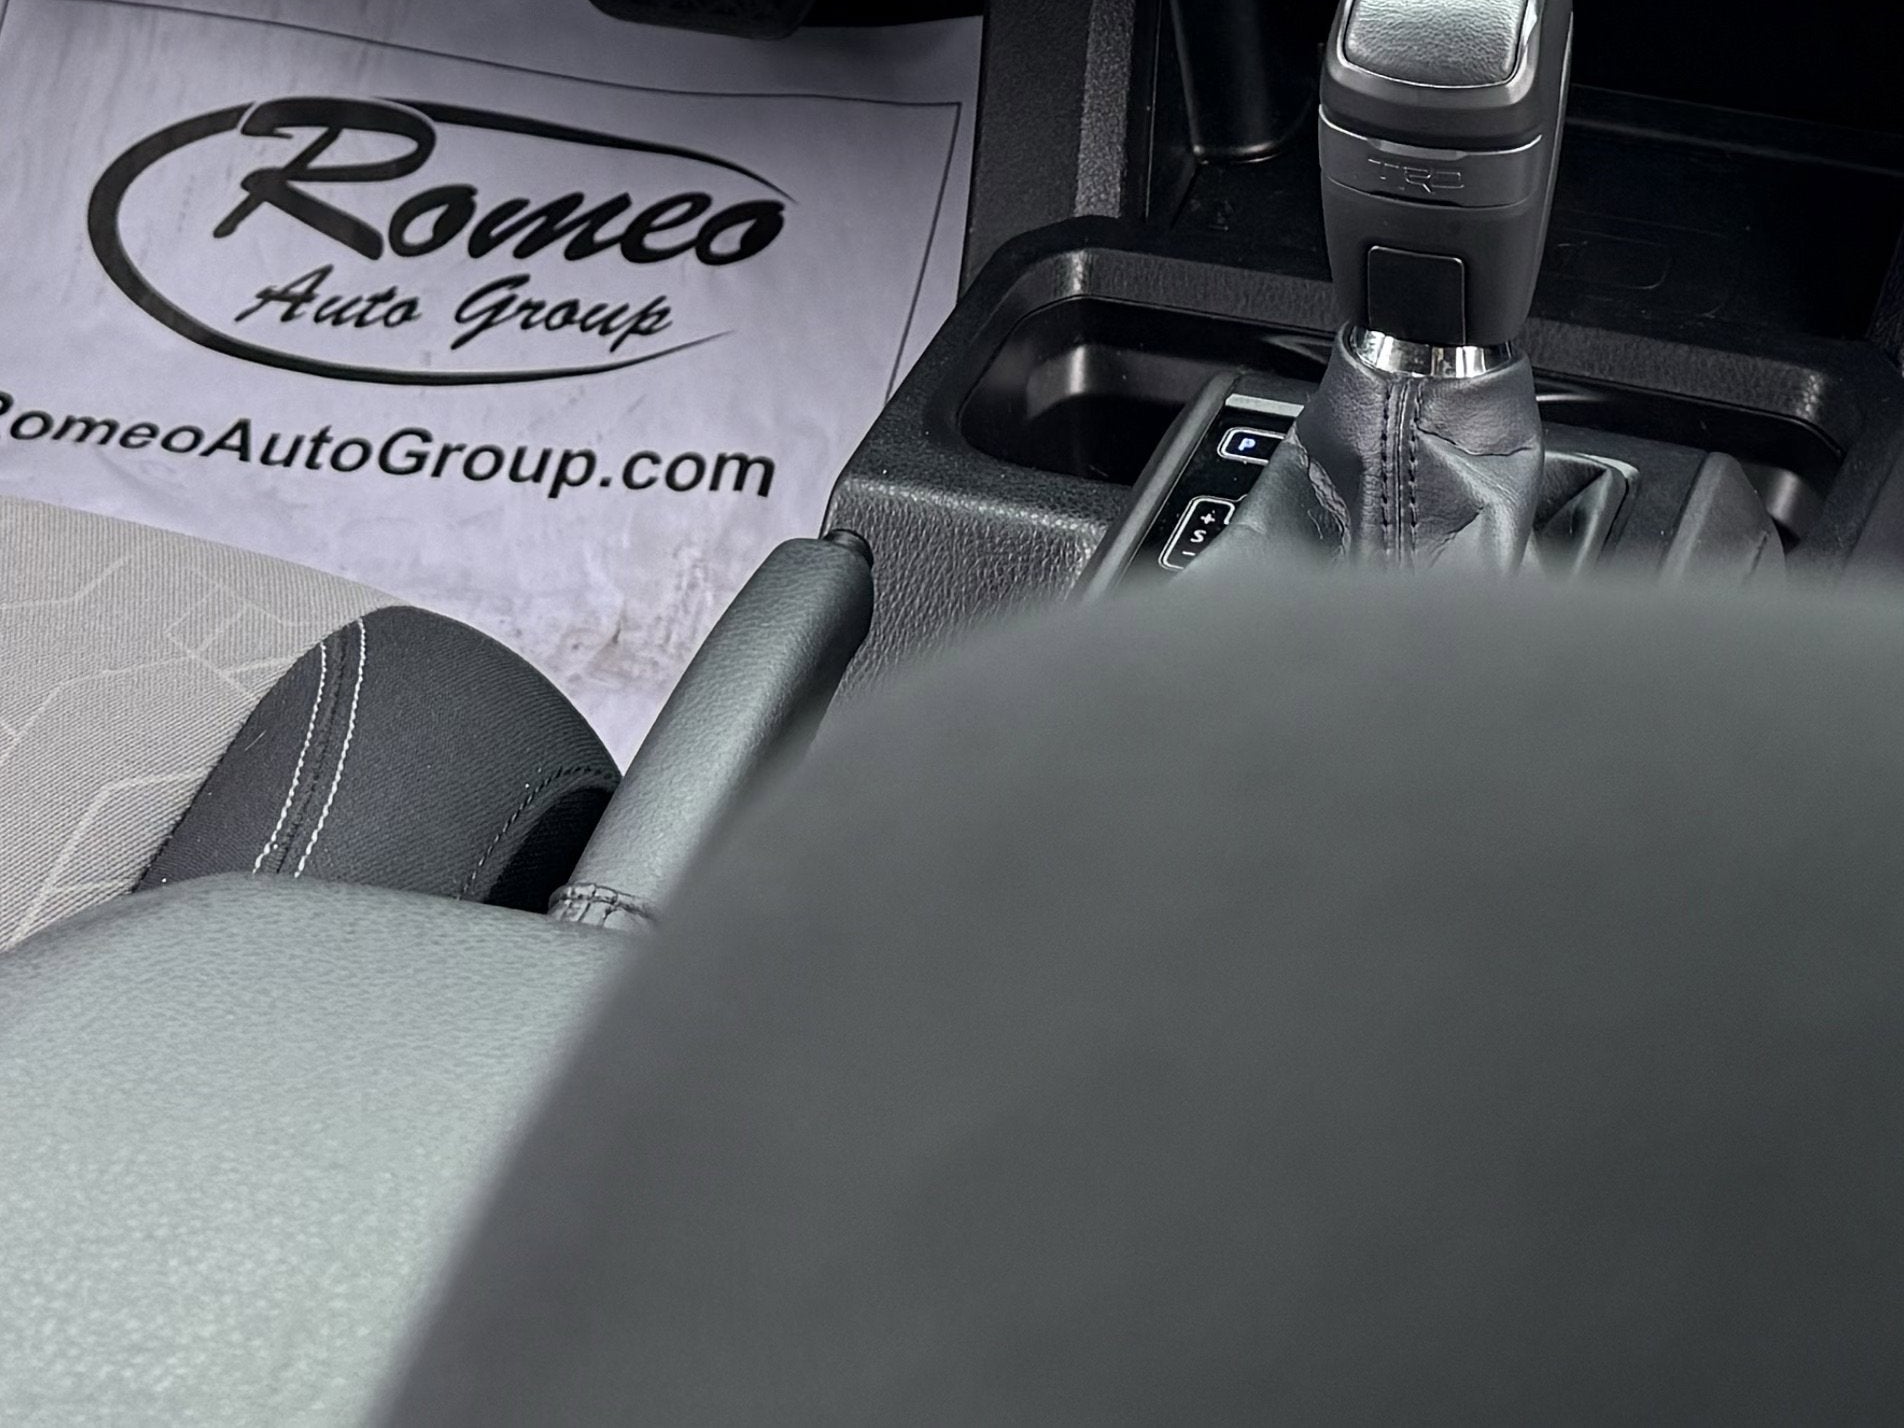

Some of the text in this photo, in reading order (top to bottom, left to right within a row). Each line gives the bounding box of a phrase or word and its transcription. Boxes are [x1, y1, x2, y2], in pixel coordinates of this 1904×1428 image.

[211, 95, 788, 266] Romeo
[236, 264, 673, 353] Auto Group
[1238, 437, 1257, 452] P
[1190, 529, 1208, 544] S
